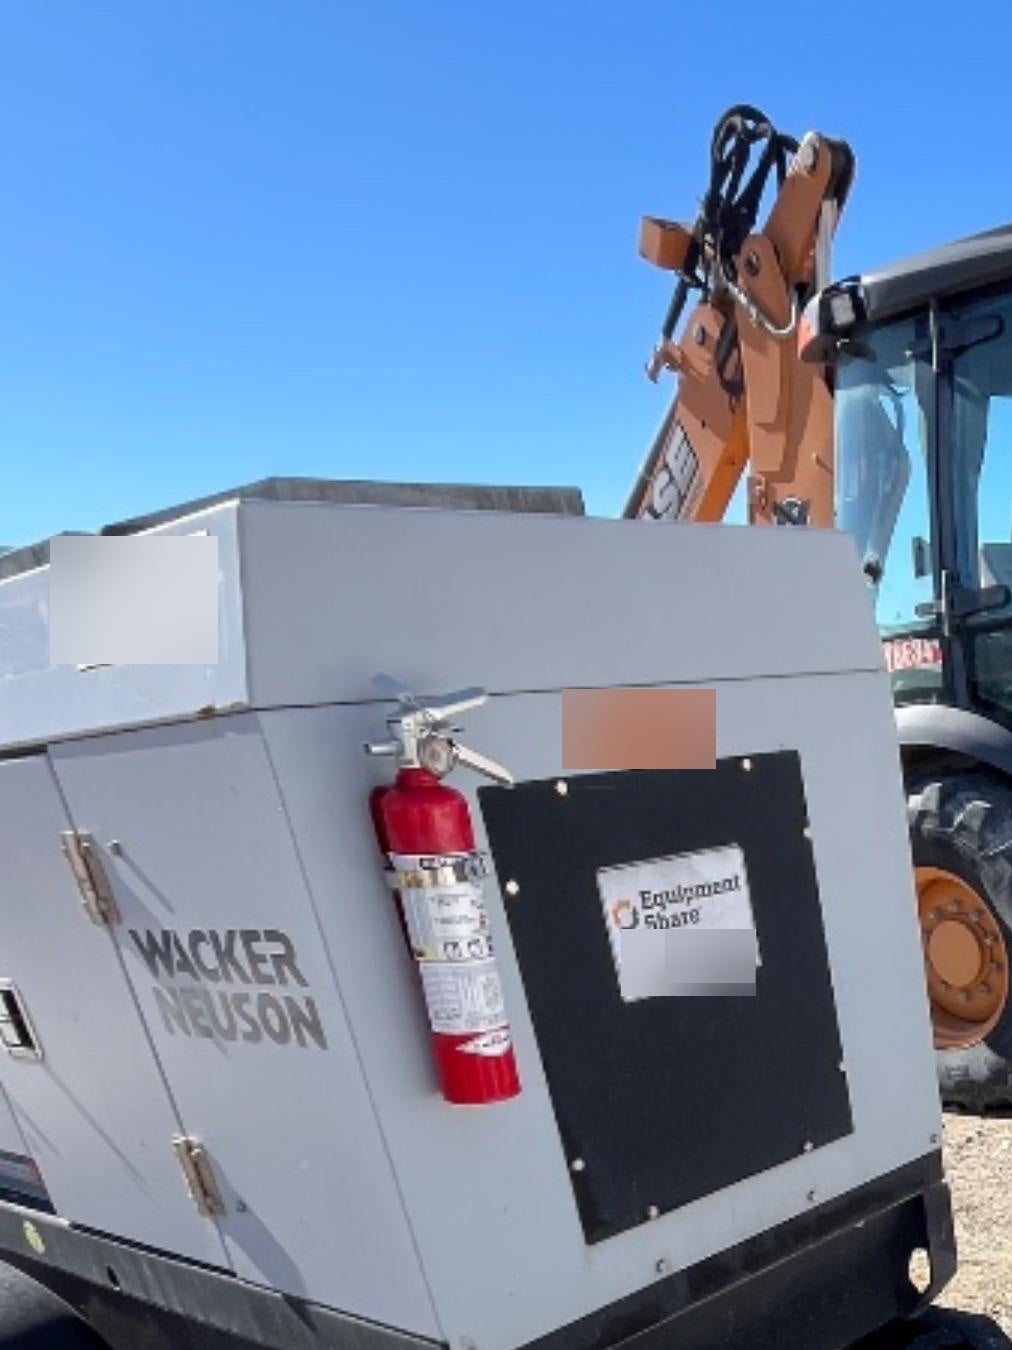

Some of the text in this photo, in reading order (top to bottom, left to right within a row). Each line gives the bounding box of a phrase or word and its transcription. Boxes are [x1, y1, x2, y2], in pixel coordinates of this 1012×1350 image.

[638, 875, 741, 911] Equipment
[644, 908, 700, 930] Share
[127, 929, 310, 988] WACKER
[152, 986, 329, 1051] NEUSON
